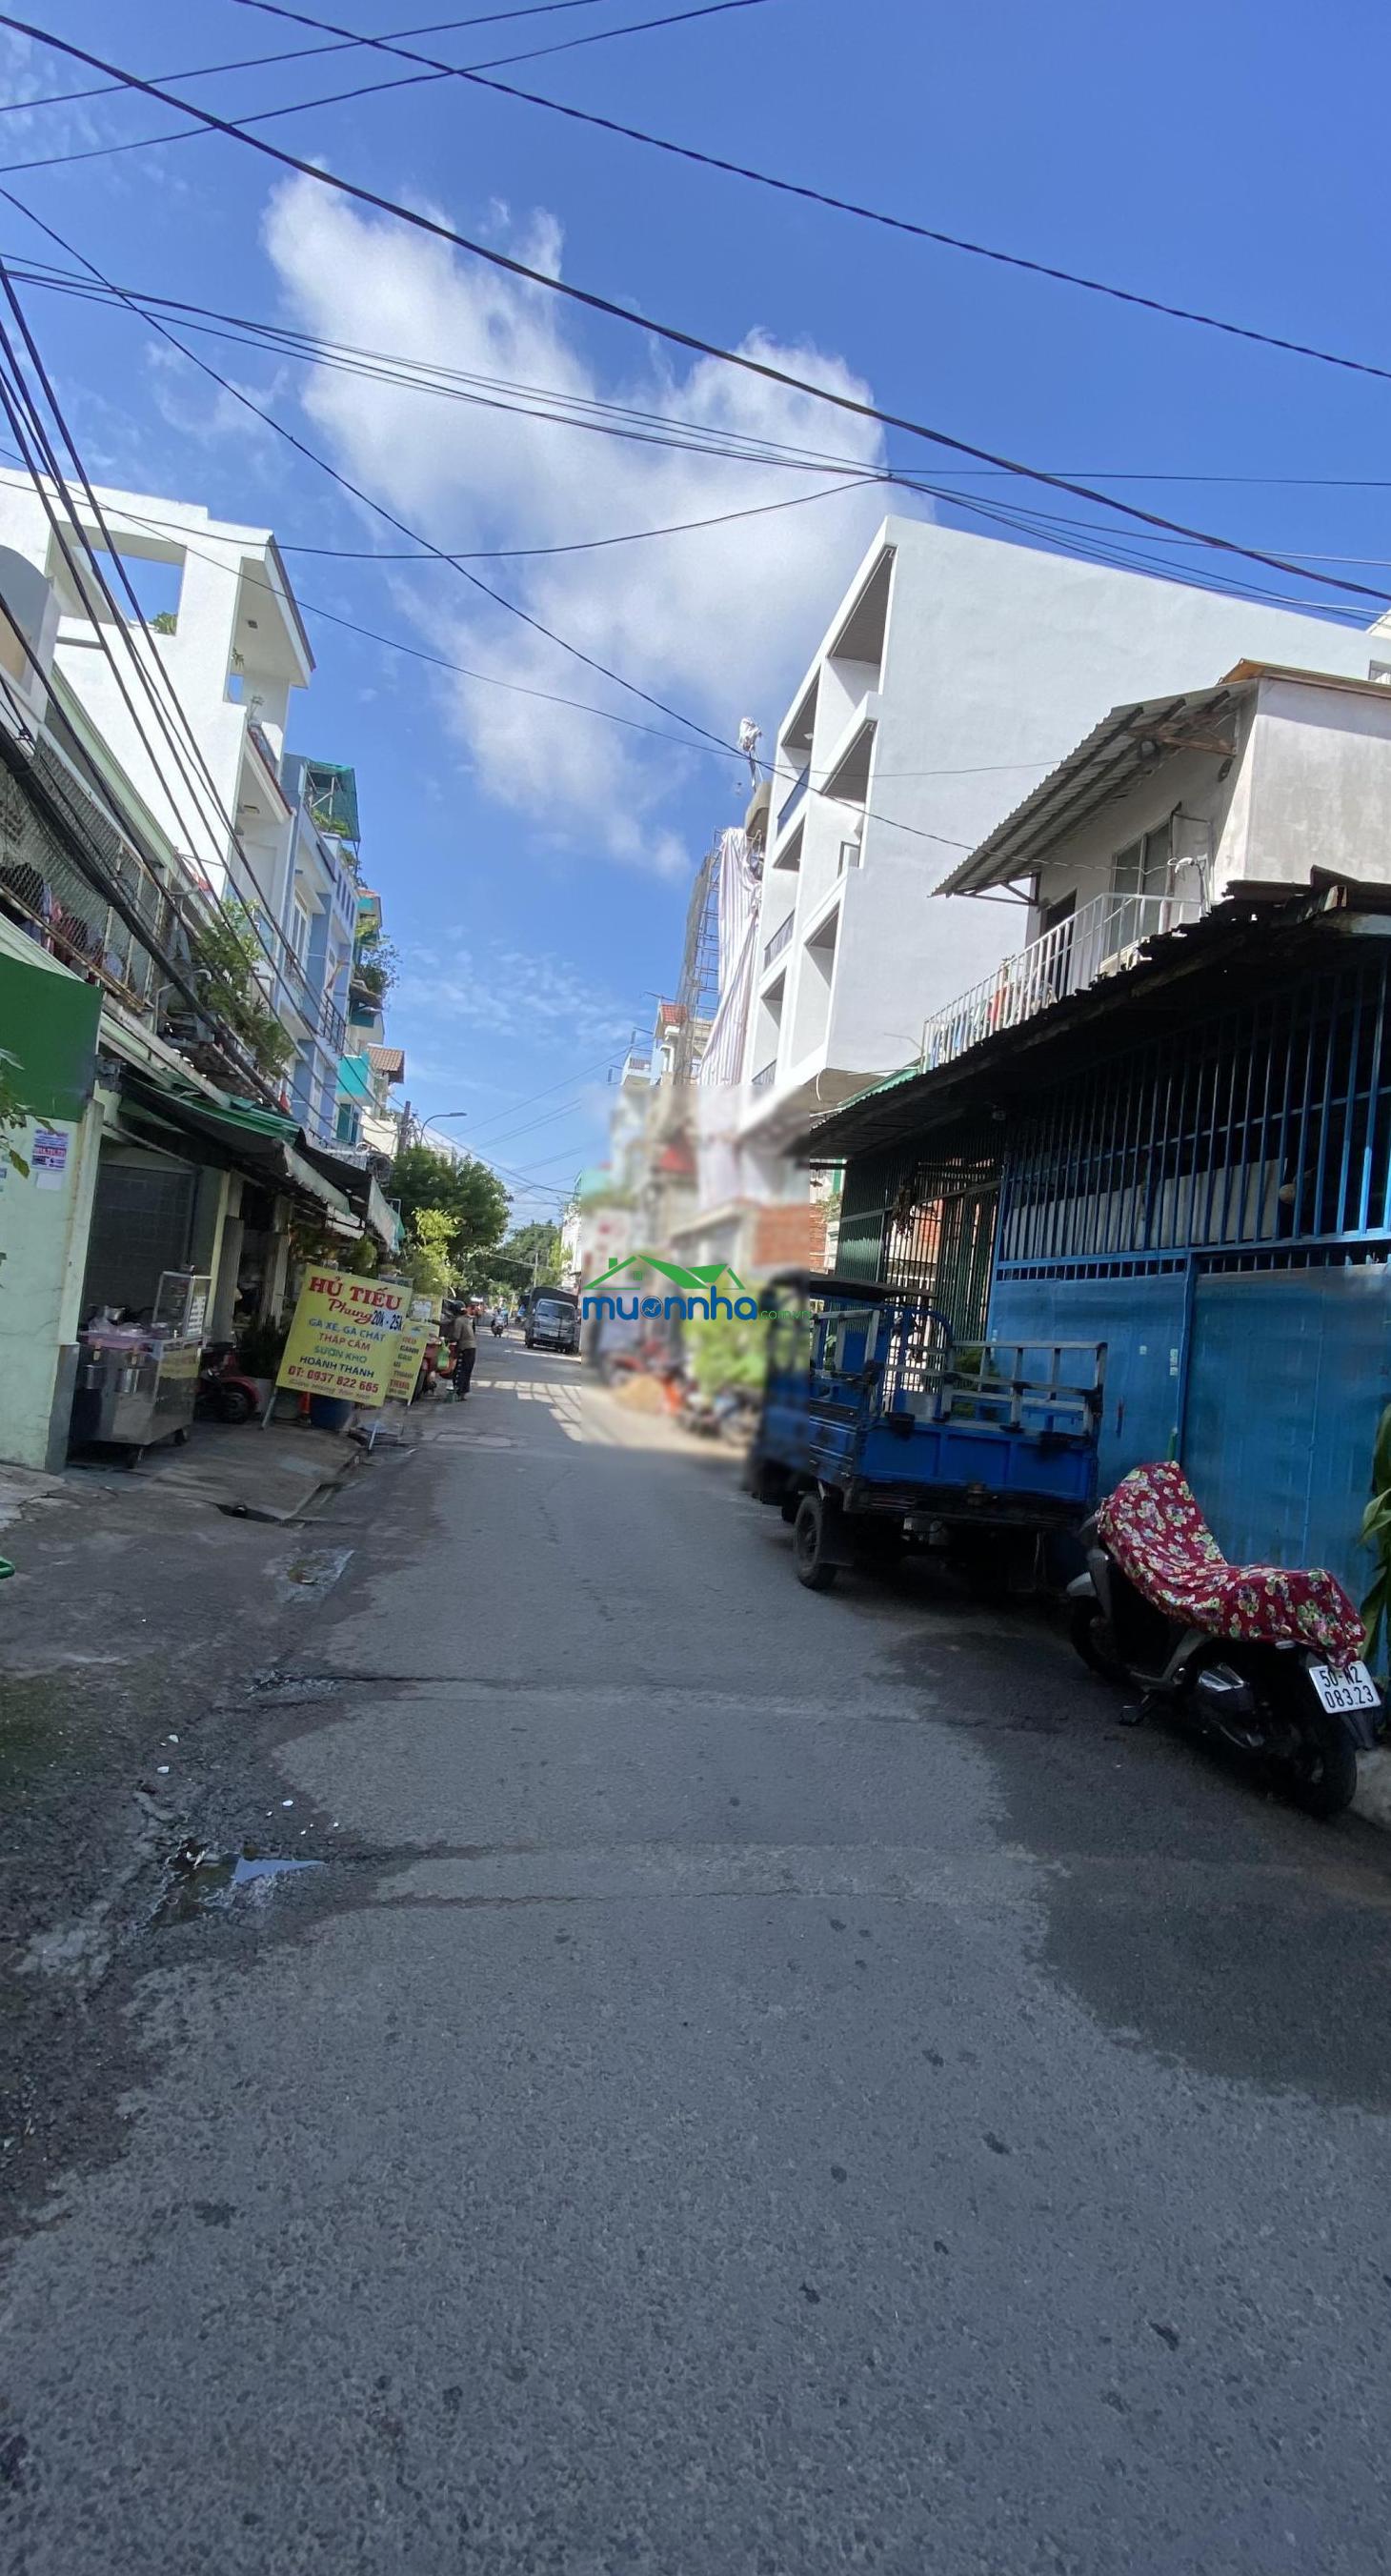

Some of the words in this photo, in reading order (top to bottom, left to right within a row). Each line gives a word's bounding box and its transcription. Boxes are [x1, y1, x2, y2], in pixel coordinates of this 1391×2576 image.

[309, 1276, 343, 1297] HỦ
[350, 1287, 402, 1310] TIẾU
[307, 1370, 334, 1383] 0937
[1324, 1685, 1374, 1708] 083.23
